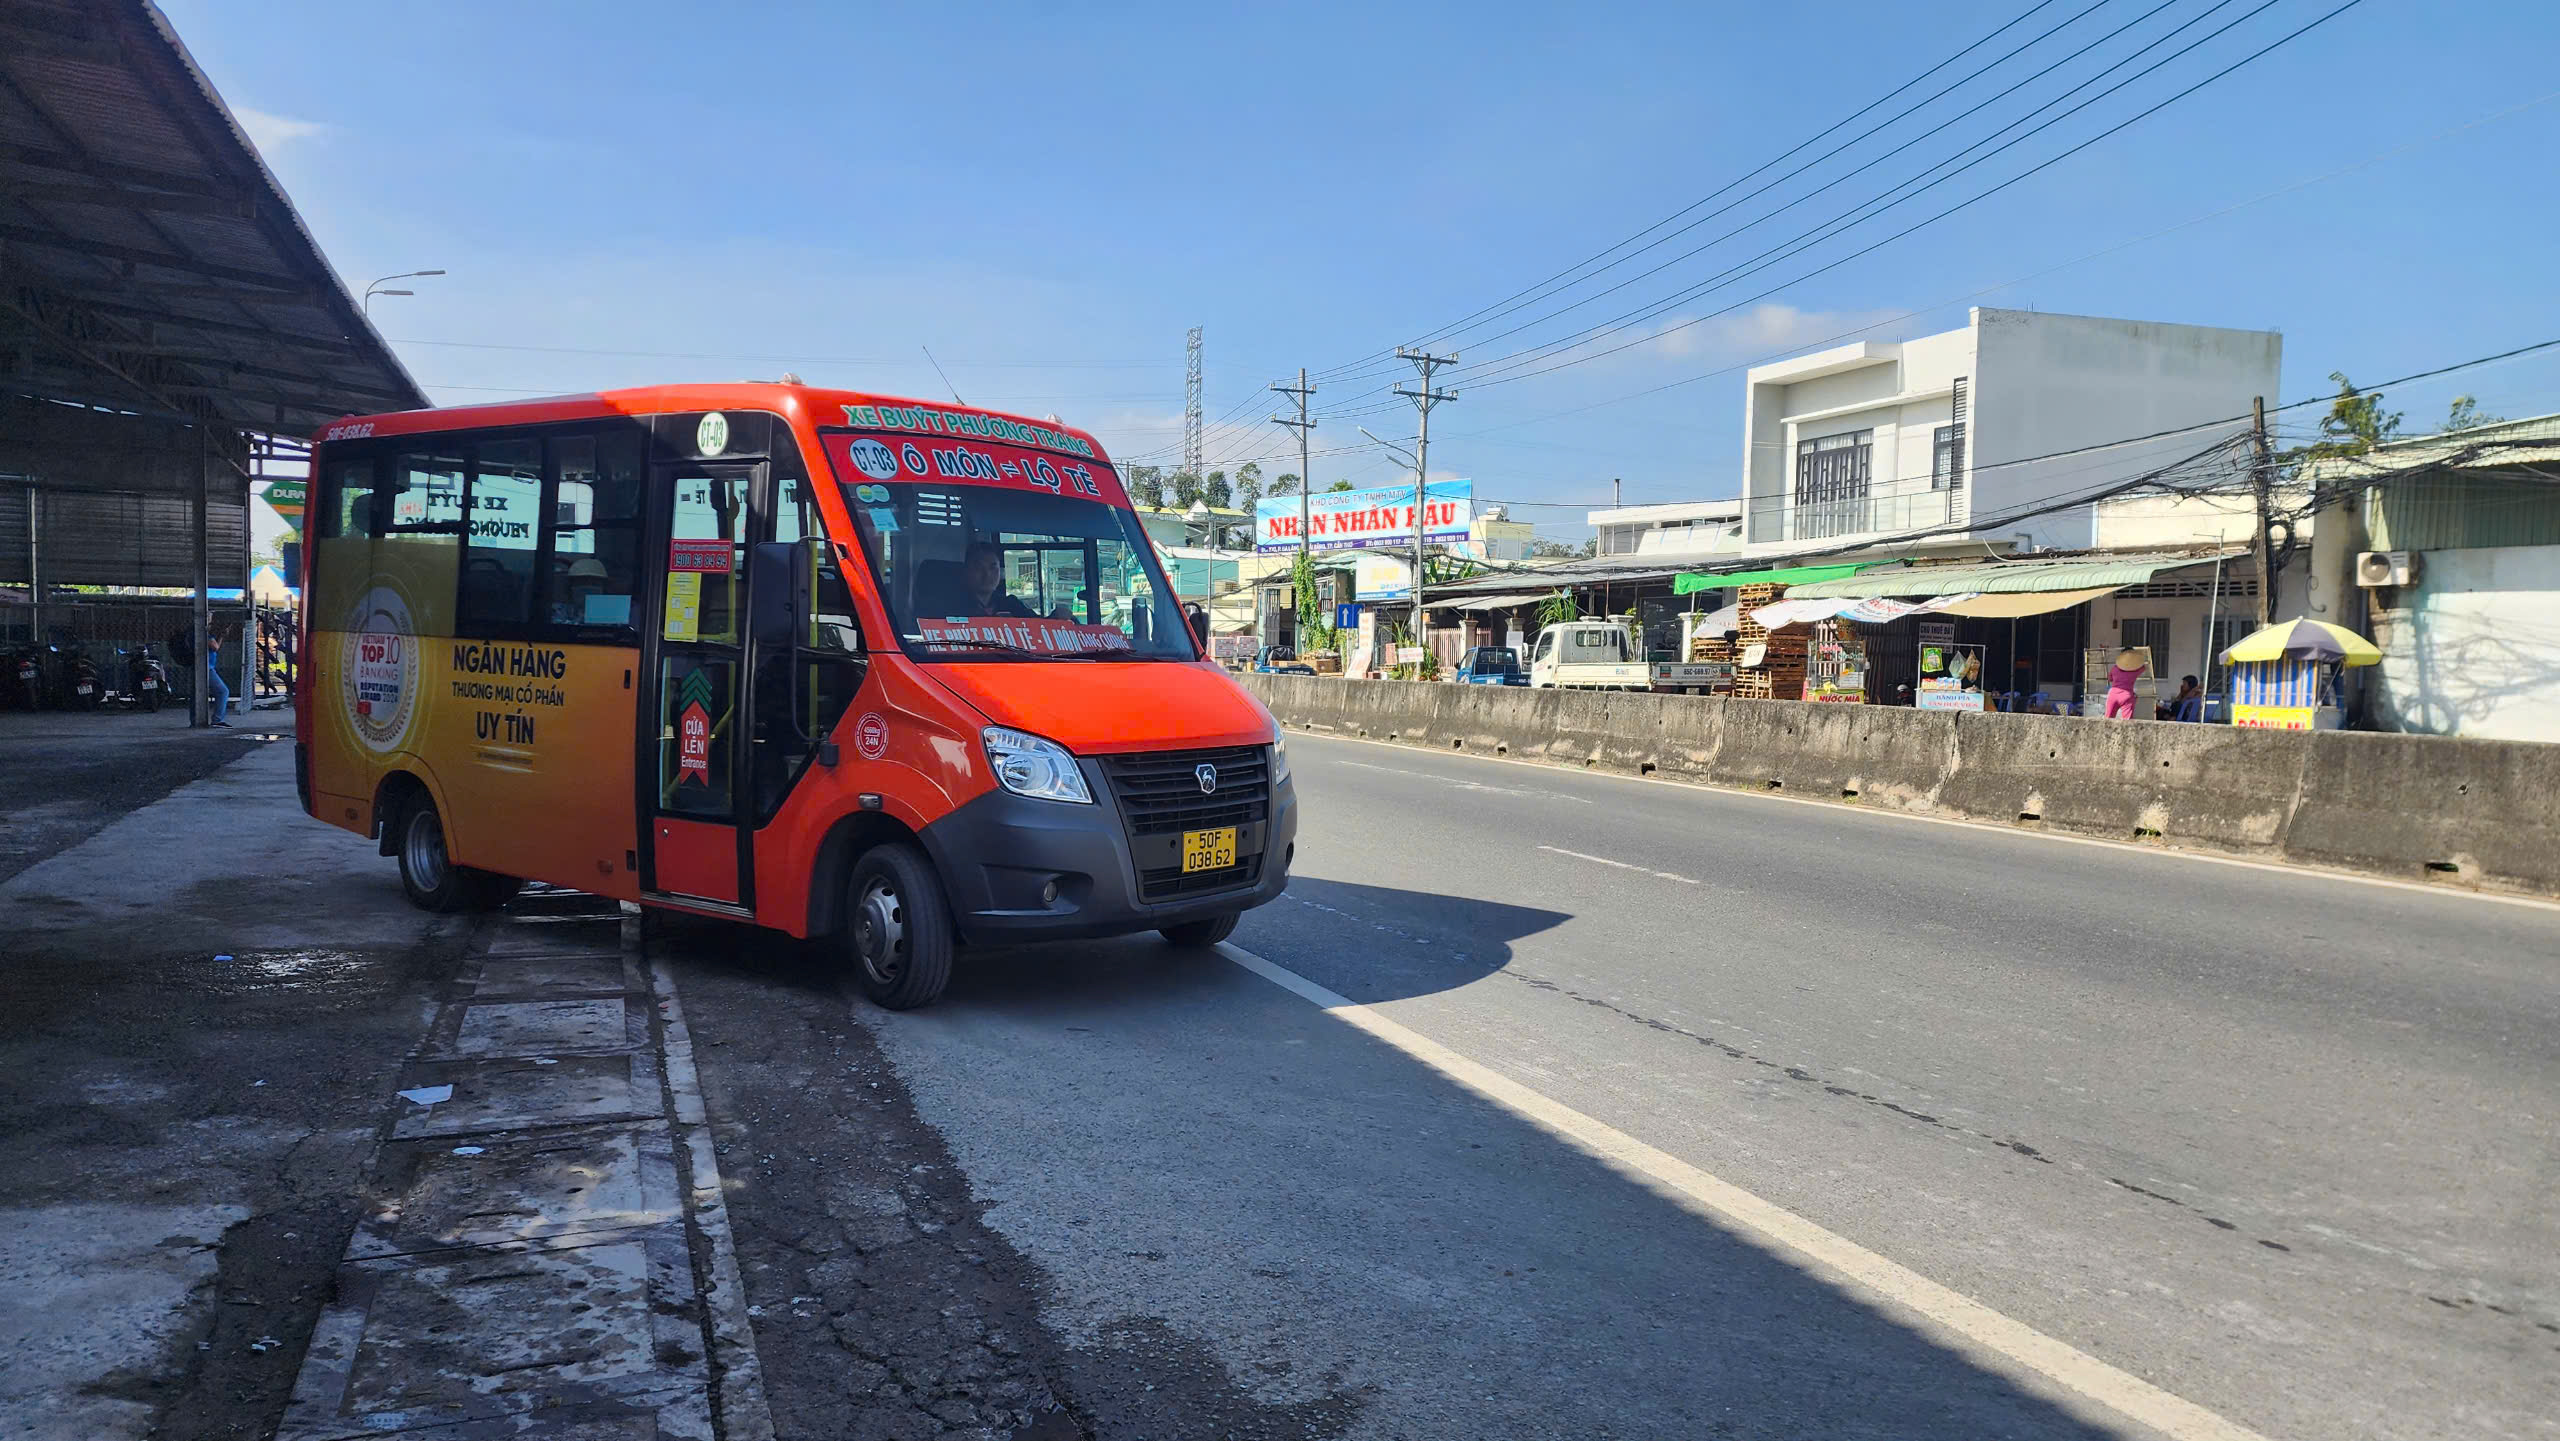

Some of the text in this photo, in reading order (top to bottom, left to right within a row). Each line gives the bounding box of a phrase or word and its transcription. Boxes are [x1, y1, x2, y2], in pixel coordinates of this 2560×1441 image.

[327, 422, 375, 441] 50F-038.62
[700, 420, 725, 448] CT-03
[840, 404, 1095, 458] XE BUÝT PHƯƠNG TRANG
[852, 442, 1102, 497] CT-03 Ô MÔN LỘ TẺ
[1353, 493, 1364, 504] TY
[1365, 491, 1387, 502] TNHH
[1388, 489, 1407, 501] MTV
[1269, 514, 1327, 538] NHN
[1334, 503, 1398, 534] NHÂN
[673, 553, 691, 567] 1900
[362, 634, 385, 645] VIETNAM
[361, 635, 401, 665] TOP 10
[453, 639, 566, 680] NGÂN HÀNG
[360, 665, 399, 682] BANKING
[360, 681, 399, 694] REPUTATION
[452, 681, 493, 700] THƯƠNG
[495, 685, 514, 706] MẠI
[360, 692, 382, 702] AWARD
[1819, 693, 1843, 703] NƯỚC
[476, 708, 534, 744] UY TÍN
[685, 716, 704, 736] CỬA
[684, 736, 704, 754] LÊN
[865, 736, 879, 746] 24N
[681, 756, 706, 769] Entrance
[1199, 831, 1222, 849] 50F
[1189, 848, 1230, 870] 038.62
